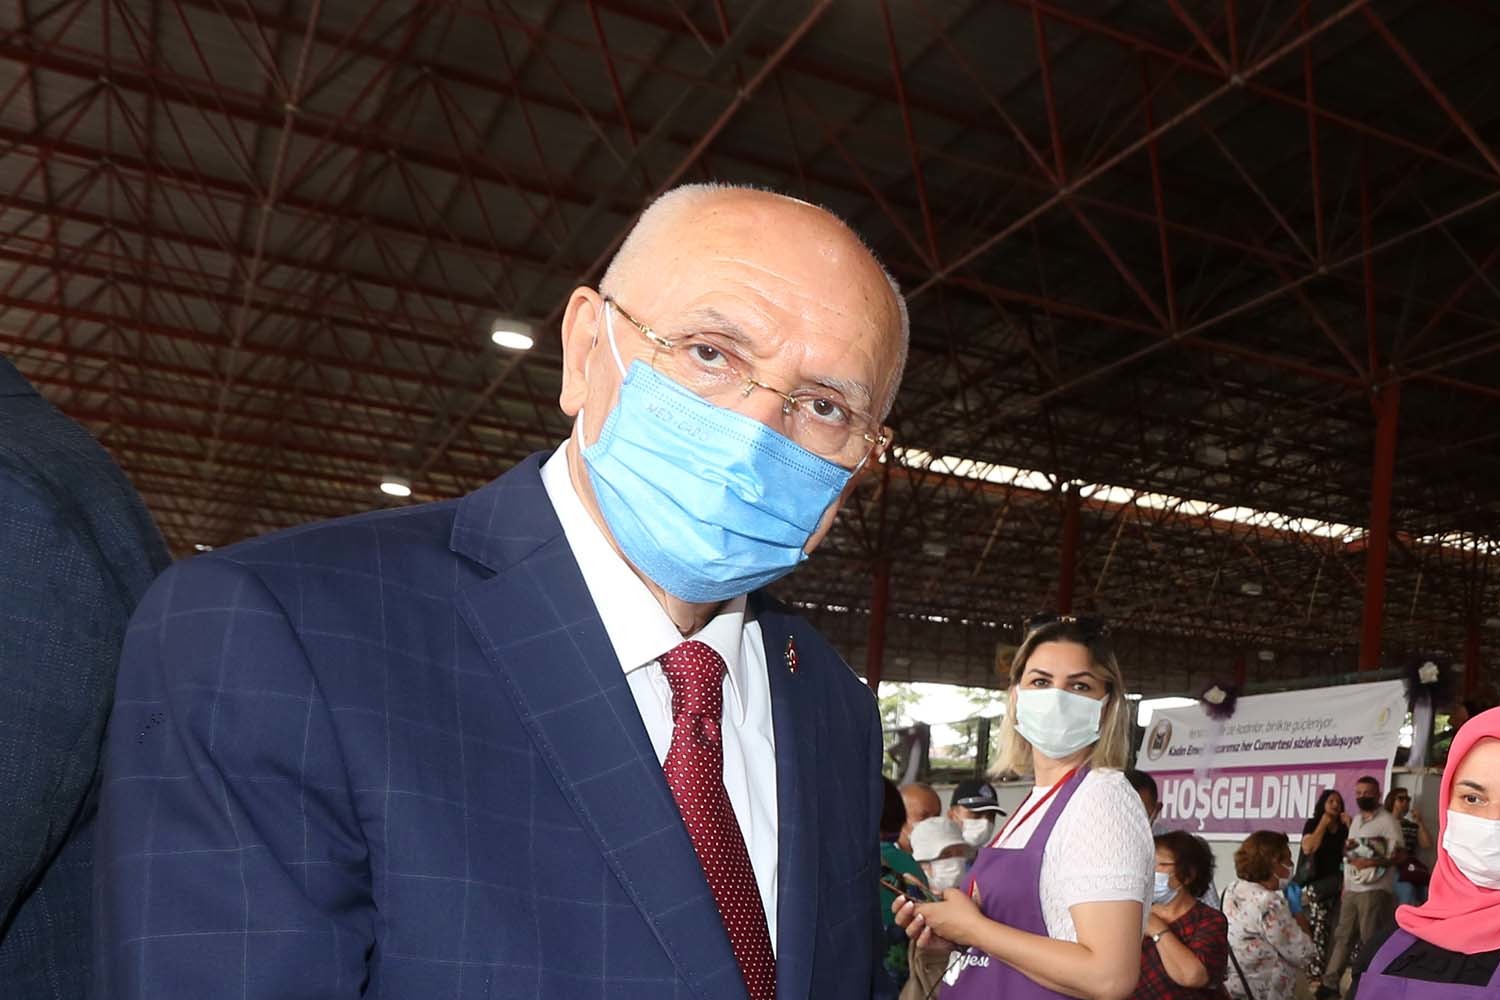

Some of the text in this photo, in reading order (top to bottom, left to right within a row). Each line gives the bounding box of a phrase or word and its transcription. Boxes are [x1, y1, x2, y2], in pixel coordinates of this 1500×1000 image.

[1242, 740, 1253, 752] her
[1253, 737, 1295, 751] Cumartesi
[1293, 735, 1322, 750] sizlerle
[1322, 734, 1364, 750] buluşuyor
